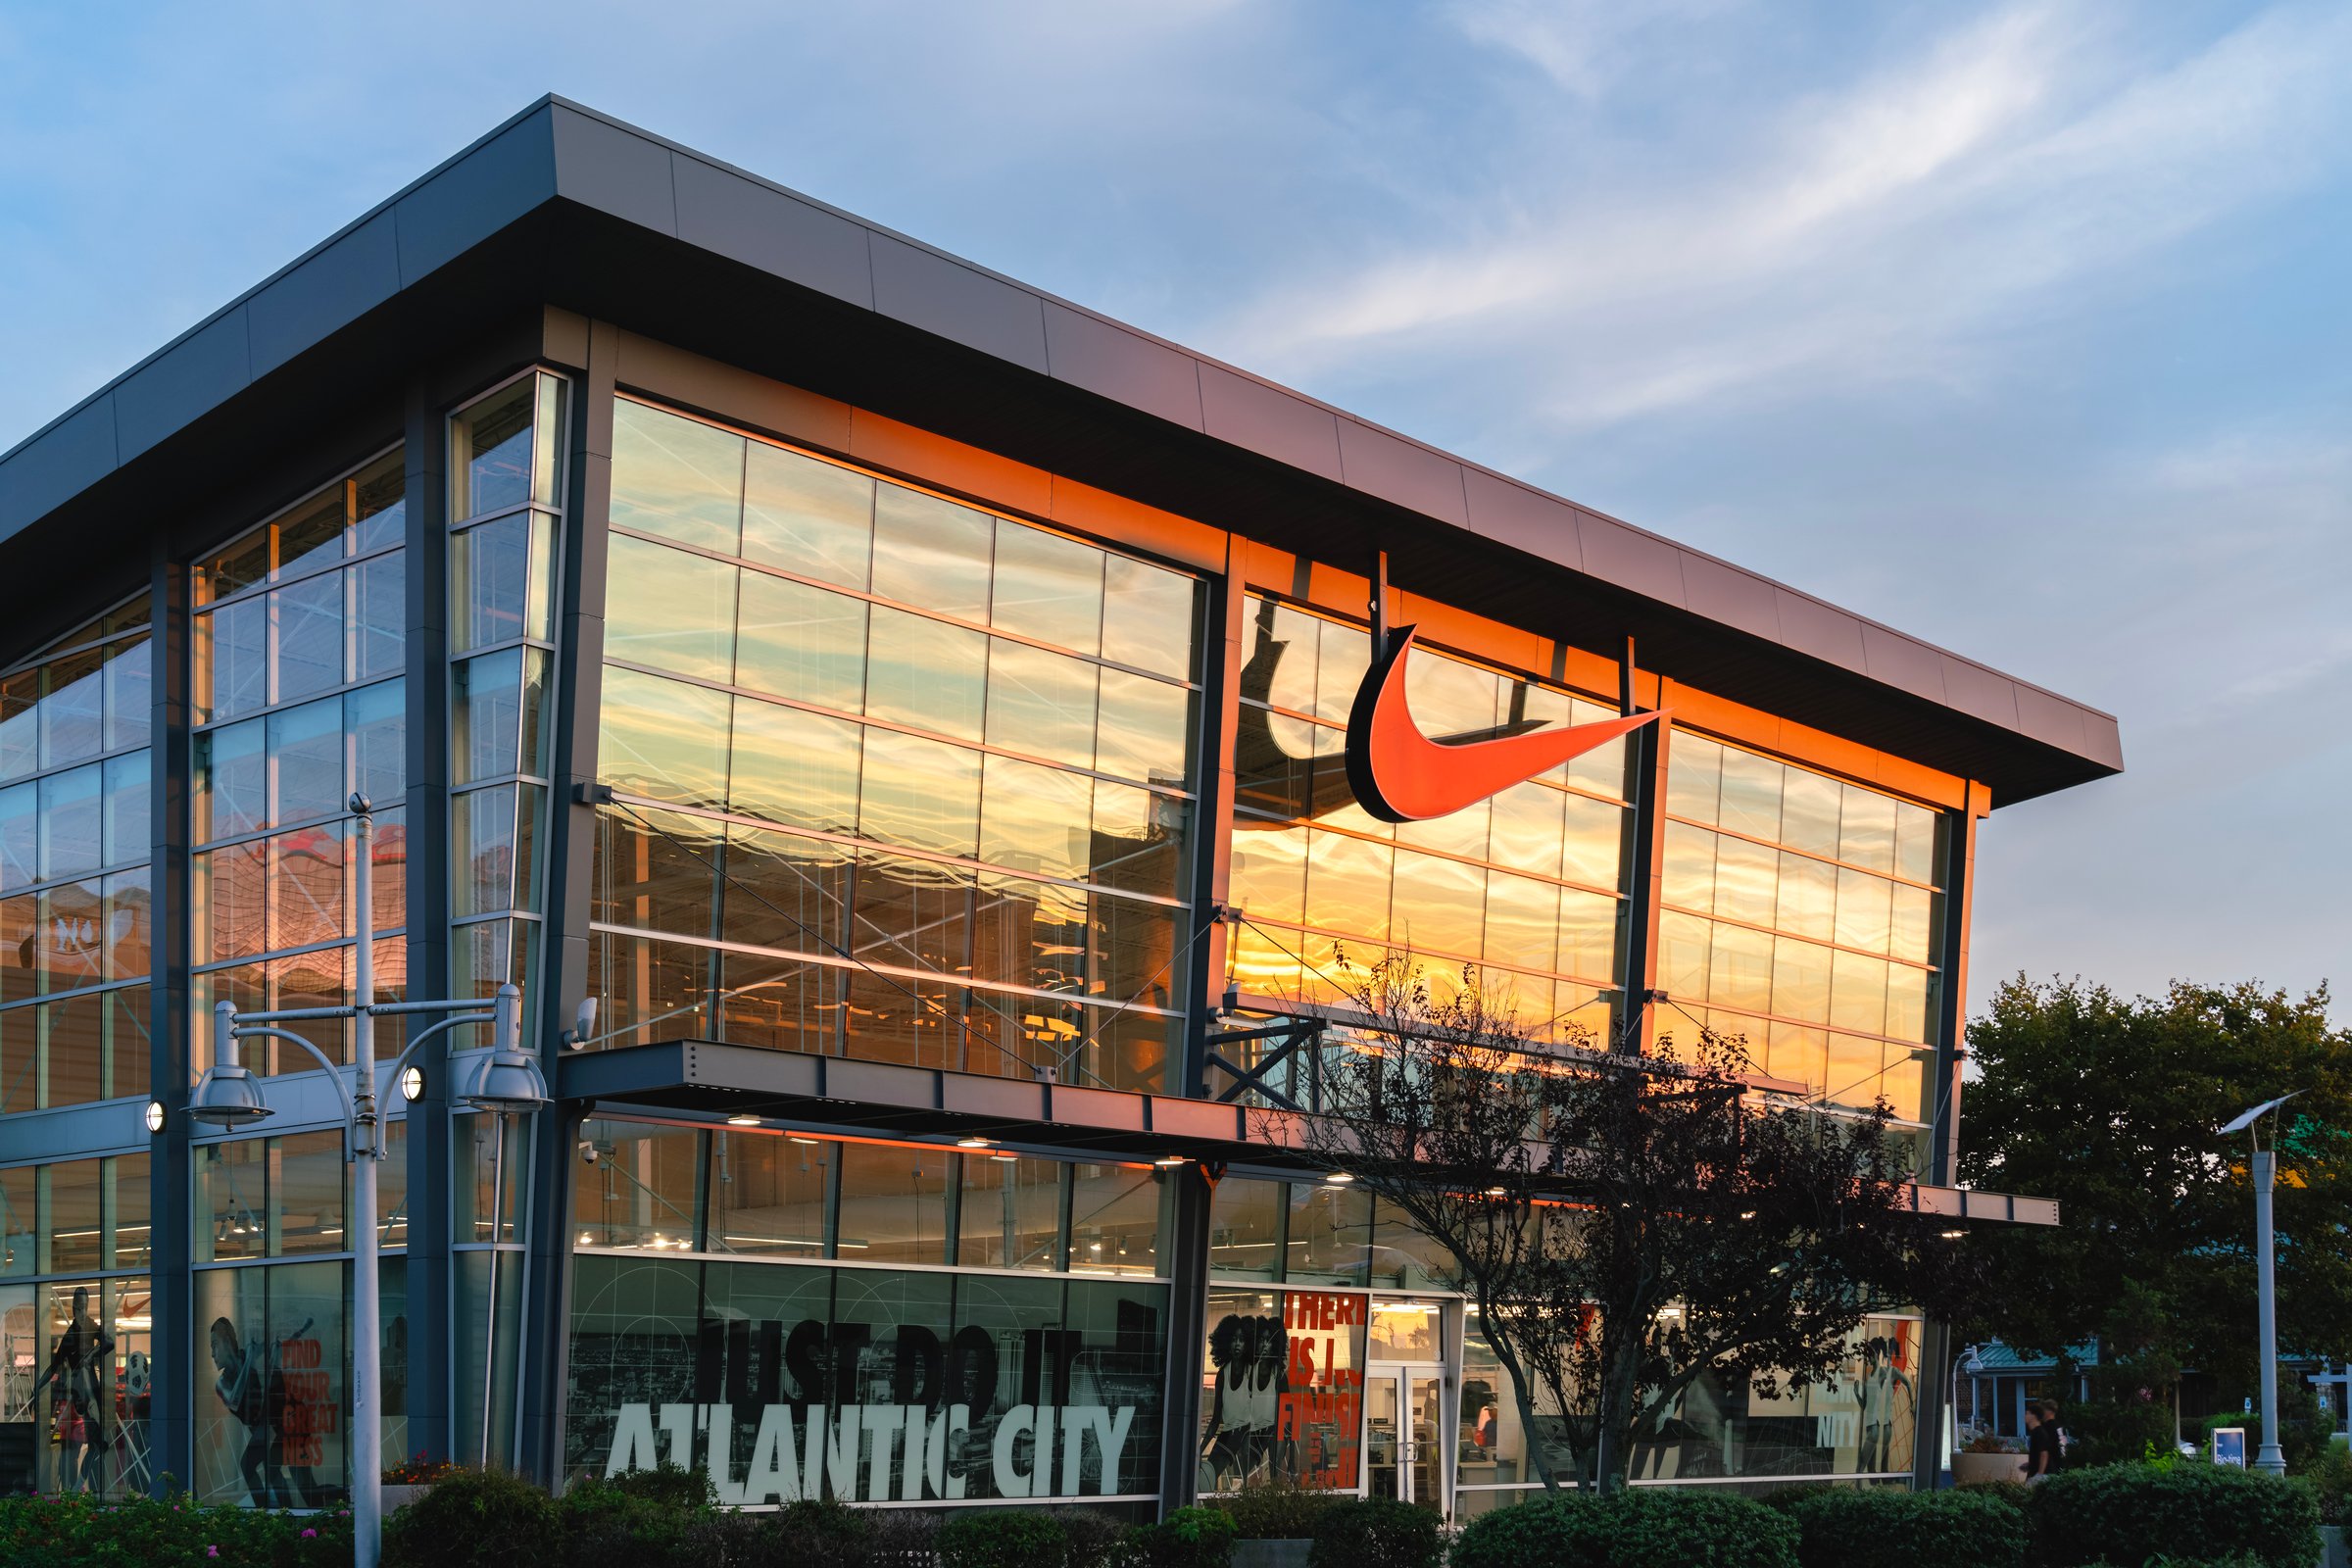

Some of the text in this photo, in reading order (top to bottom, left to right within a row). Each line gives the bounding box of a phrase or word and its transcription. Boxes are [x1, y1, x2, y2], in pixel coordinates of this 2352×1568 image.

[282, 1339, 321, 1368] FIND
[1288, 1337, 1315, 1386] IS
[281, 1371, 330, 1401] YOUR
[695, 1319, 1083, 1428] JUST DO IT
[282, 1402, 338, 1433] GREAT
[282, 1436, 323, 1467] NESS
[605, 1403, 1137, 1505] ATLANTIC CITY
